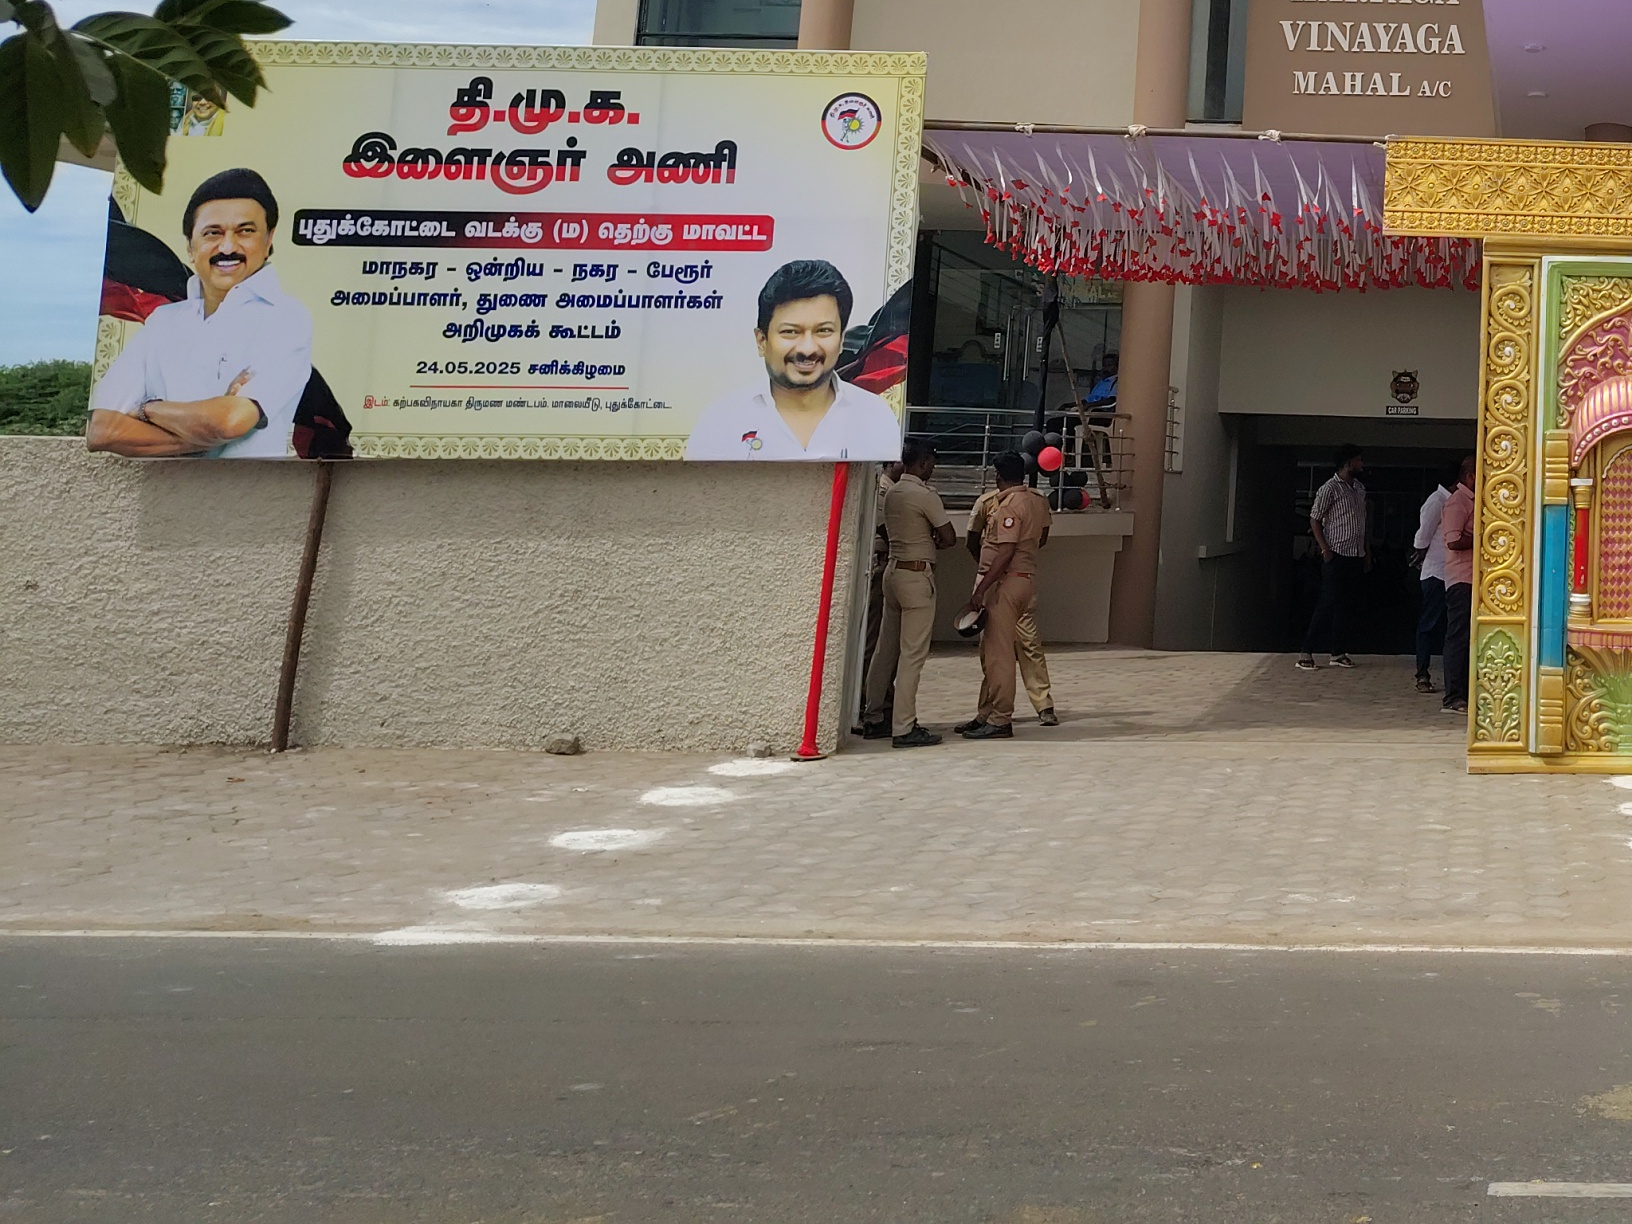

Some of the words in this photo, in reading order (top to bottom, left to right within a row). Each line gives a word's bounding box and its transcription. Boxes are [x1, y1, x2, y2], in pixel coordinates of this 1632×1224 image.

[1279, 20, 1466, 55] VINAYAGA
[1292, 70, 1411, 96] MAHAL
[1417, 80, 1452, 97] A/C
[446, 75, 640, 136] தி.மு.க.
[342, 131, 587, 195] இளைஞர்
[606, 139, 738, 186] அணி
[298, 213, 456, 245] புதுக்கோட்டை
[464, 216, 544, 244] வடக்கு
[552, 218, 589, 244] (ம)
[597, 218, 674, 246] தெற்கு
[682, 223, 768, 241] மாவட்ட
[361, 259, 439, 281] மாநகர
[465, 256, 545, 283] ஒன்றிய
[571, 262, 619, 283] நகர
[646, 259, 714, 285] பேரூர்
[330, 286, 468, 310] அமைப்பாளர்,
[475, 292, 548, 315] துணை
[555, 288, 724, 310] அமைப்பாளர்கள்
[442, 317, 541, 344] அறிமுகக்
[548, 319, 622, 339] கூட்டம்
[416, 361, 521, 375] 24.05.2025
[527, 359, 626, 381] சனிக்கிழமை
